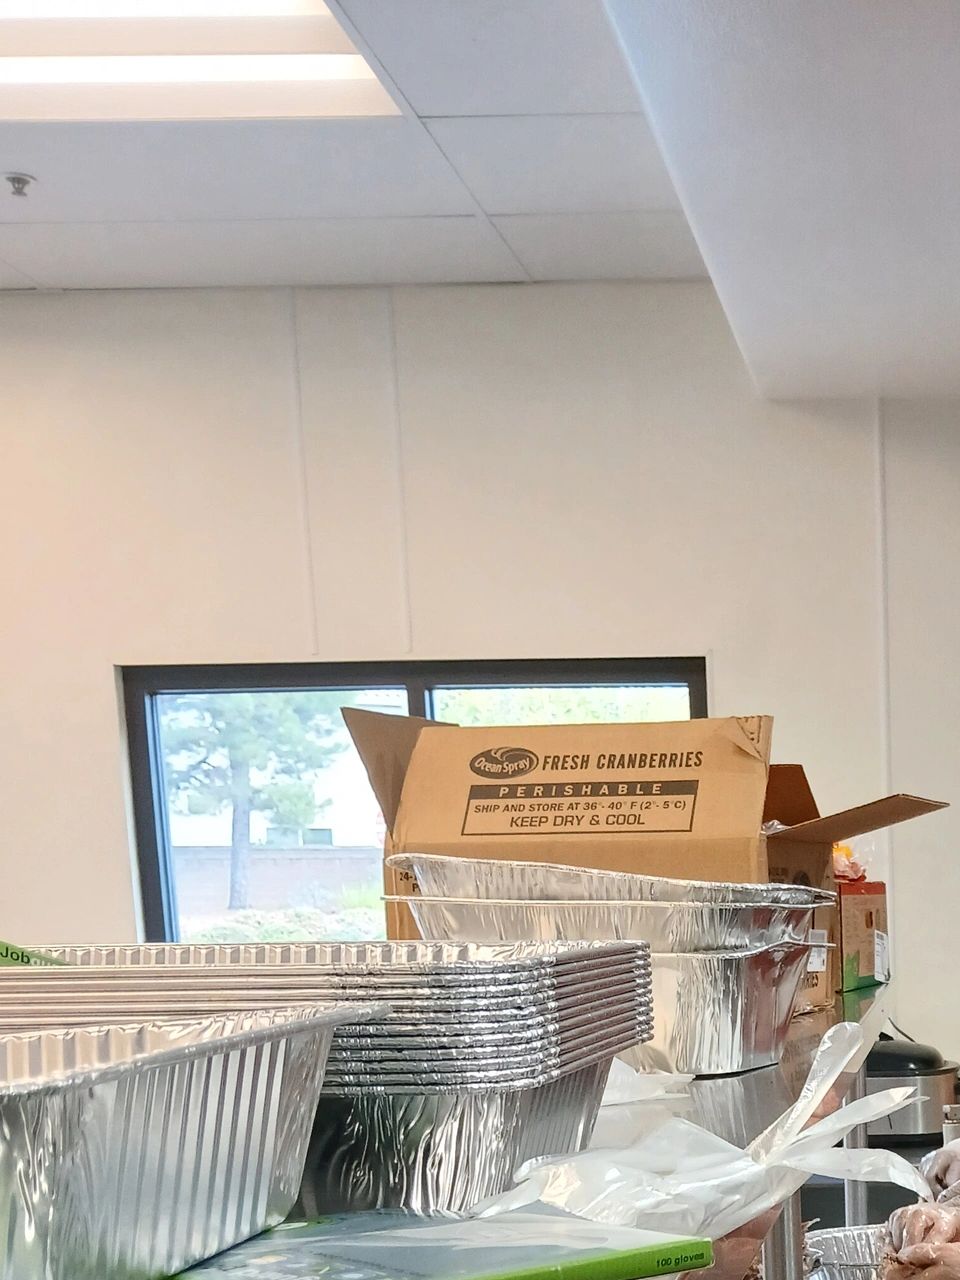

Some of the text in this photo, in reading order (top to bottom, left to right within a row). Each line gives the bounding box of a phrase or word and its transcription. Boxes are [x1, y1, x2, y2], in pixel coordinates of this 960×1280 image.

[474, 757, 530, 775] Ocean Spray
[542, 751, 704, 771] FRESH CRANBERRIES
[498, 783, 662, 798] PERISHABLE
[474, 804, 500, 814] SHIP
[502, 803, 526, 813] AND
[528, 803, 564, 812] STORE
[566, 802, 580, 811] AT
[630, 801, 638, 810] F
[510, 814, 646, 828] KEEP DRY & COOL
[656, 1252, 704, 1268] 100 gloves
